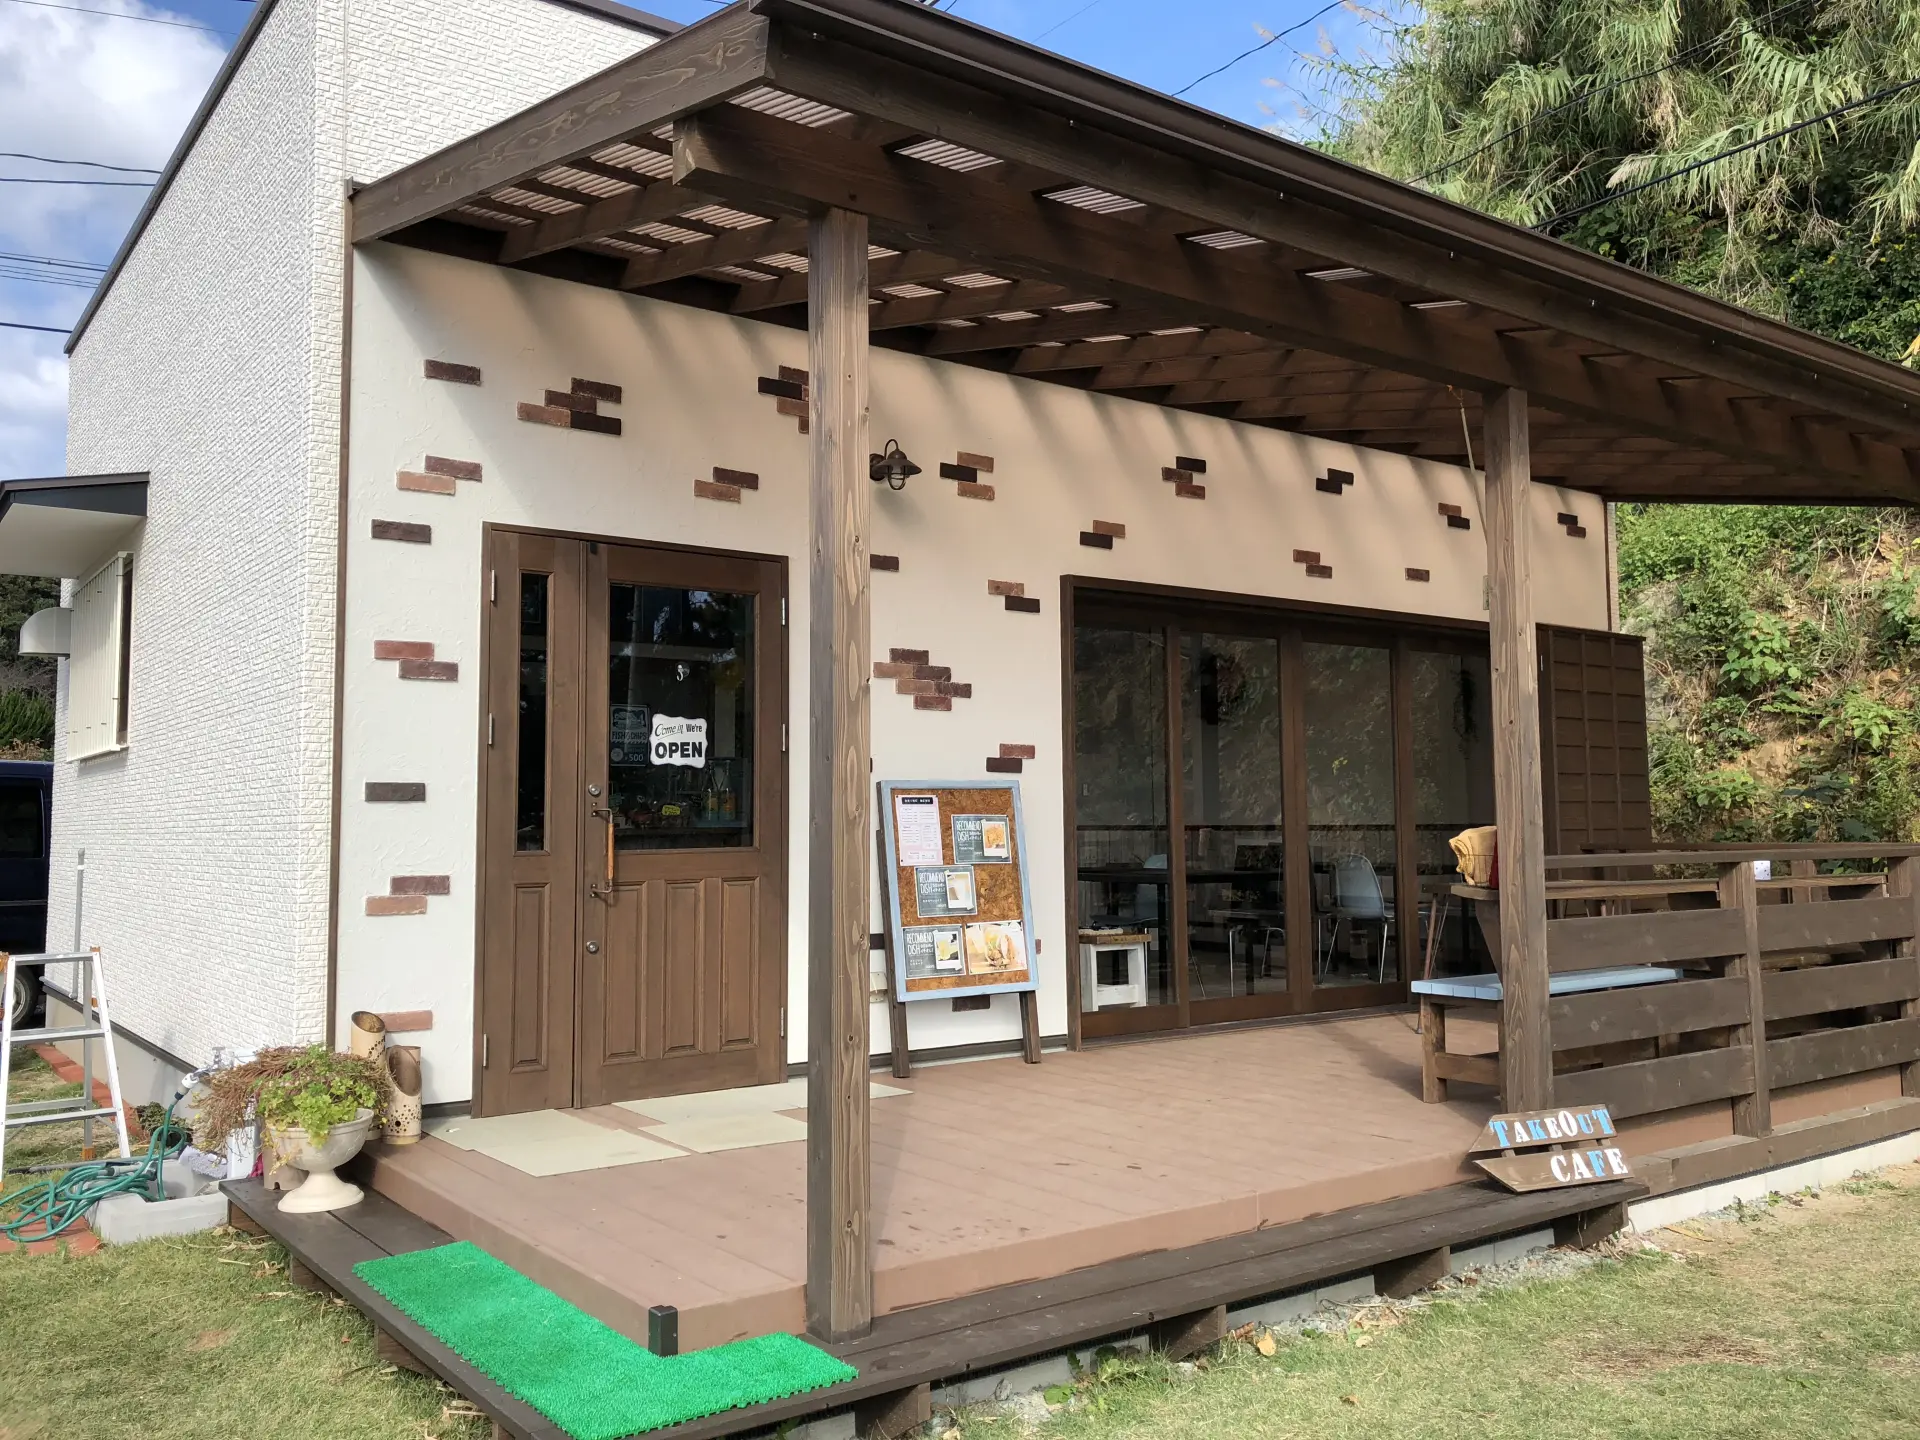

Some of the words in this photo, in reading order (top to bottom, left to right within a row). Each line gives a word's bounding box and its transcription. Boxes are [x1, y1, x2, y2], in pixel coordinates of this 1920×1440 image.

[612, 731, 625, 740] FISH
[630, 731, 648, 740] CHIPS
[654, 723, 676, 737] Come
[676, 723, 685, 735] in
[685, 723, 703, 733] We're
[654, 741, 703, 759] OPEN
[956, 820, 982, 831] RECOMMEND
[957, 831, 970, 842] DISH
[919, 872, 945, 883] RECOMMEND
[920, 883, 933, 894] DISH
[906, 932, 934, 944] RECOMMEND
[907, 943, 921, 955] DISH
[1489, 1109, 1614, 1148] TAKEOUT
[1550, 1148, 1629, 1183] CAFE
